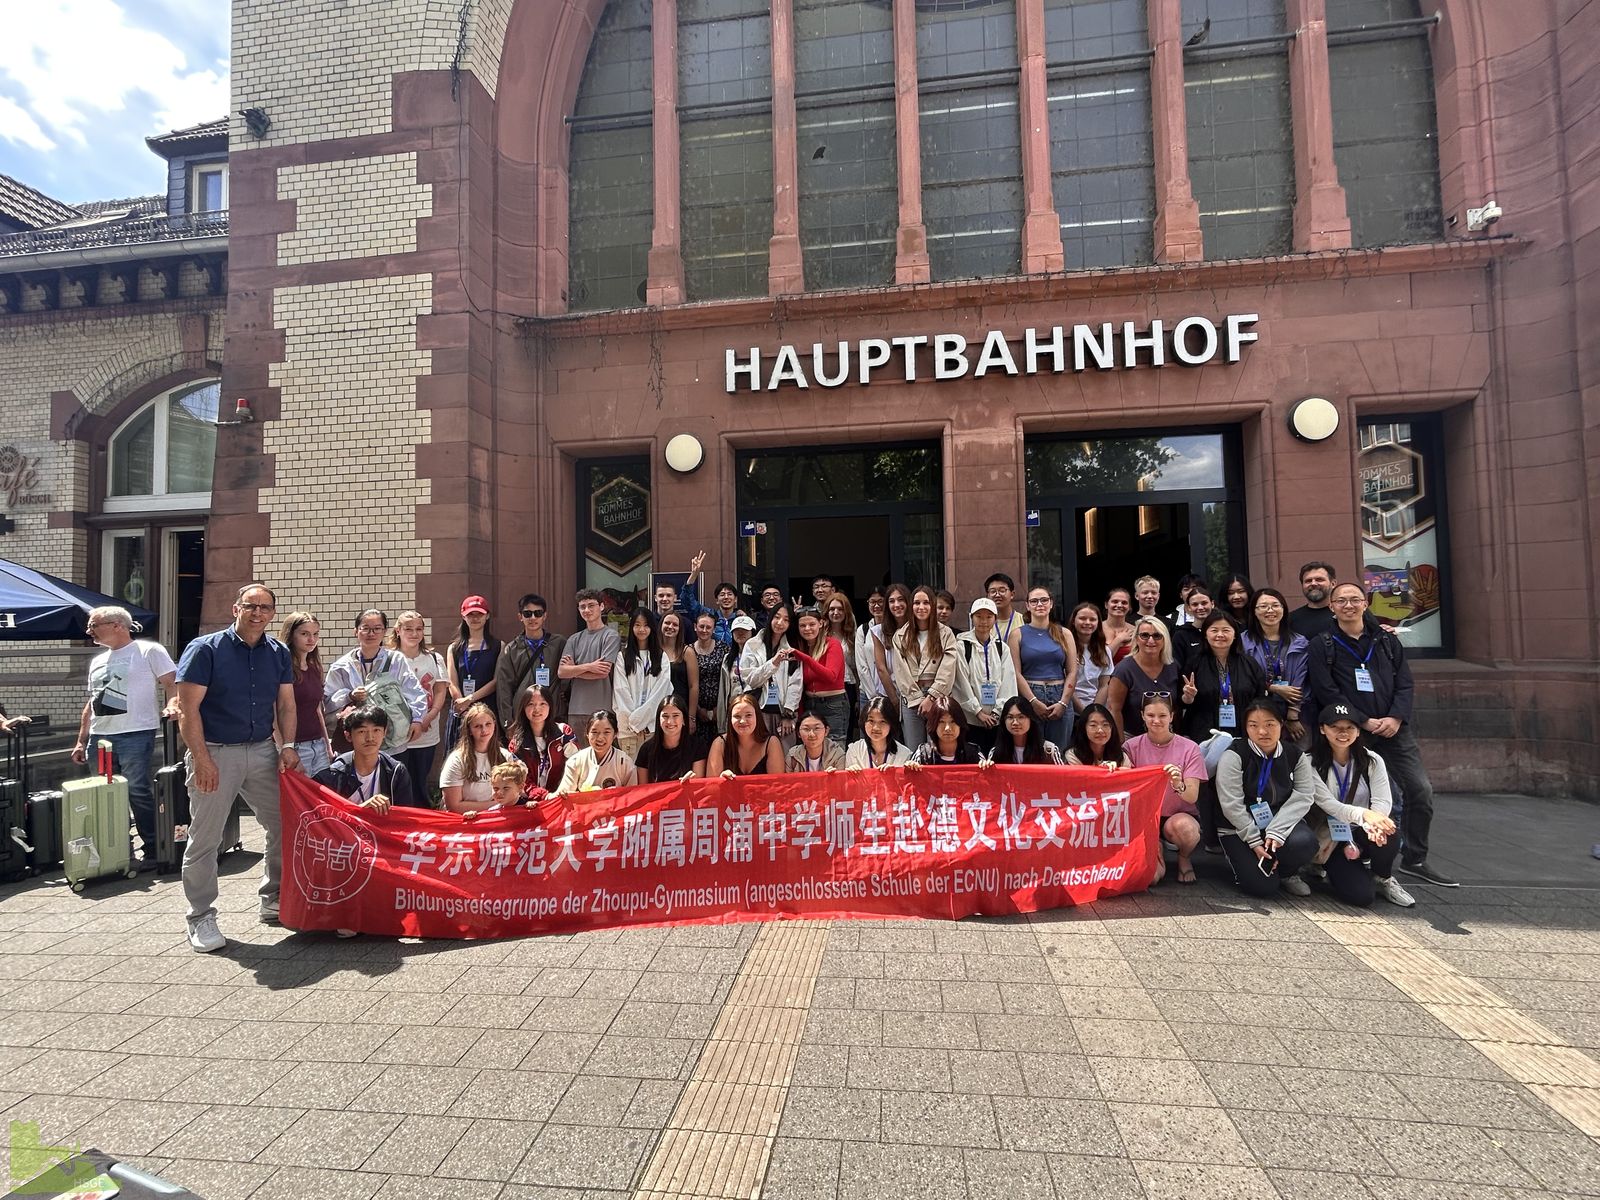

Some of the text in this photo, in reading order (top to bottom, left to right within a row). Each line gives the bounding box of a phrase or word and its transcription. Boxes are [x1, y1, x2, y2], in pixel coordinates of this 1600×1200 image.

[725, 313, 1259, 393] HAUPTBAHNHOF
[0, 455, 41, 508] afé
[1363, 473, 1413, 493] BAHNHOF
[603, 508, 642, 524] BAHNHOF
[399, 791, 1131, 876] 华东师范大学附属周浦中学师生赴德文化交流团
[394, 861, 1128, 920] Bildungsreisegruppe der Zhoupu-Gymnasium (angeschlossene Schule der ECNU) nach Deutschland
